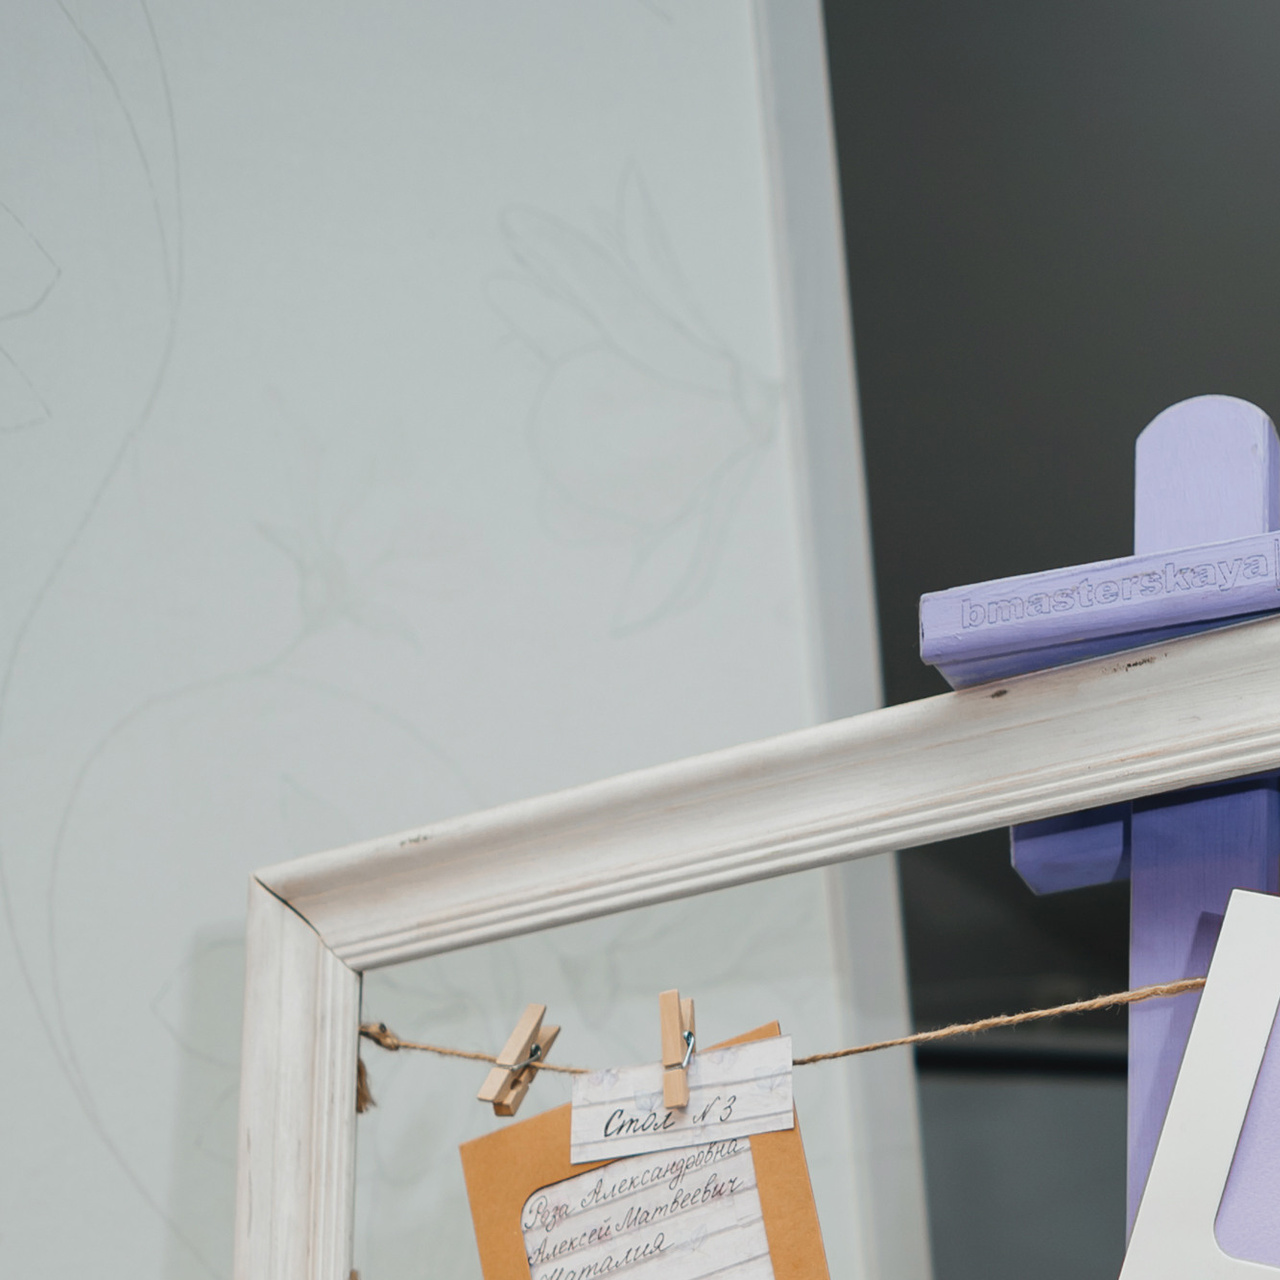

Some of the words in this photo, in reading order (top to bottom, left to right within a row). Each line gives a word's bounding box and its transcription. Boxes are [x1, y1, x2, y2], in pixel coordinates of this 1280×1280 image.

[603, 1108, 675, 1137] Стол
[719, 1095, 737, 1123] 3
[524, 1195, 575, 1232] Роза
[580, 1138, 745, 1207] Александровна
[528, 1216, 612, 1266] Алексей
[615, 1173, 744, 1233] Матвеевич
